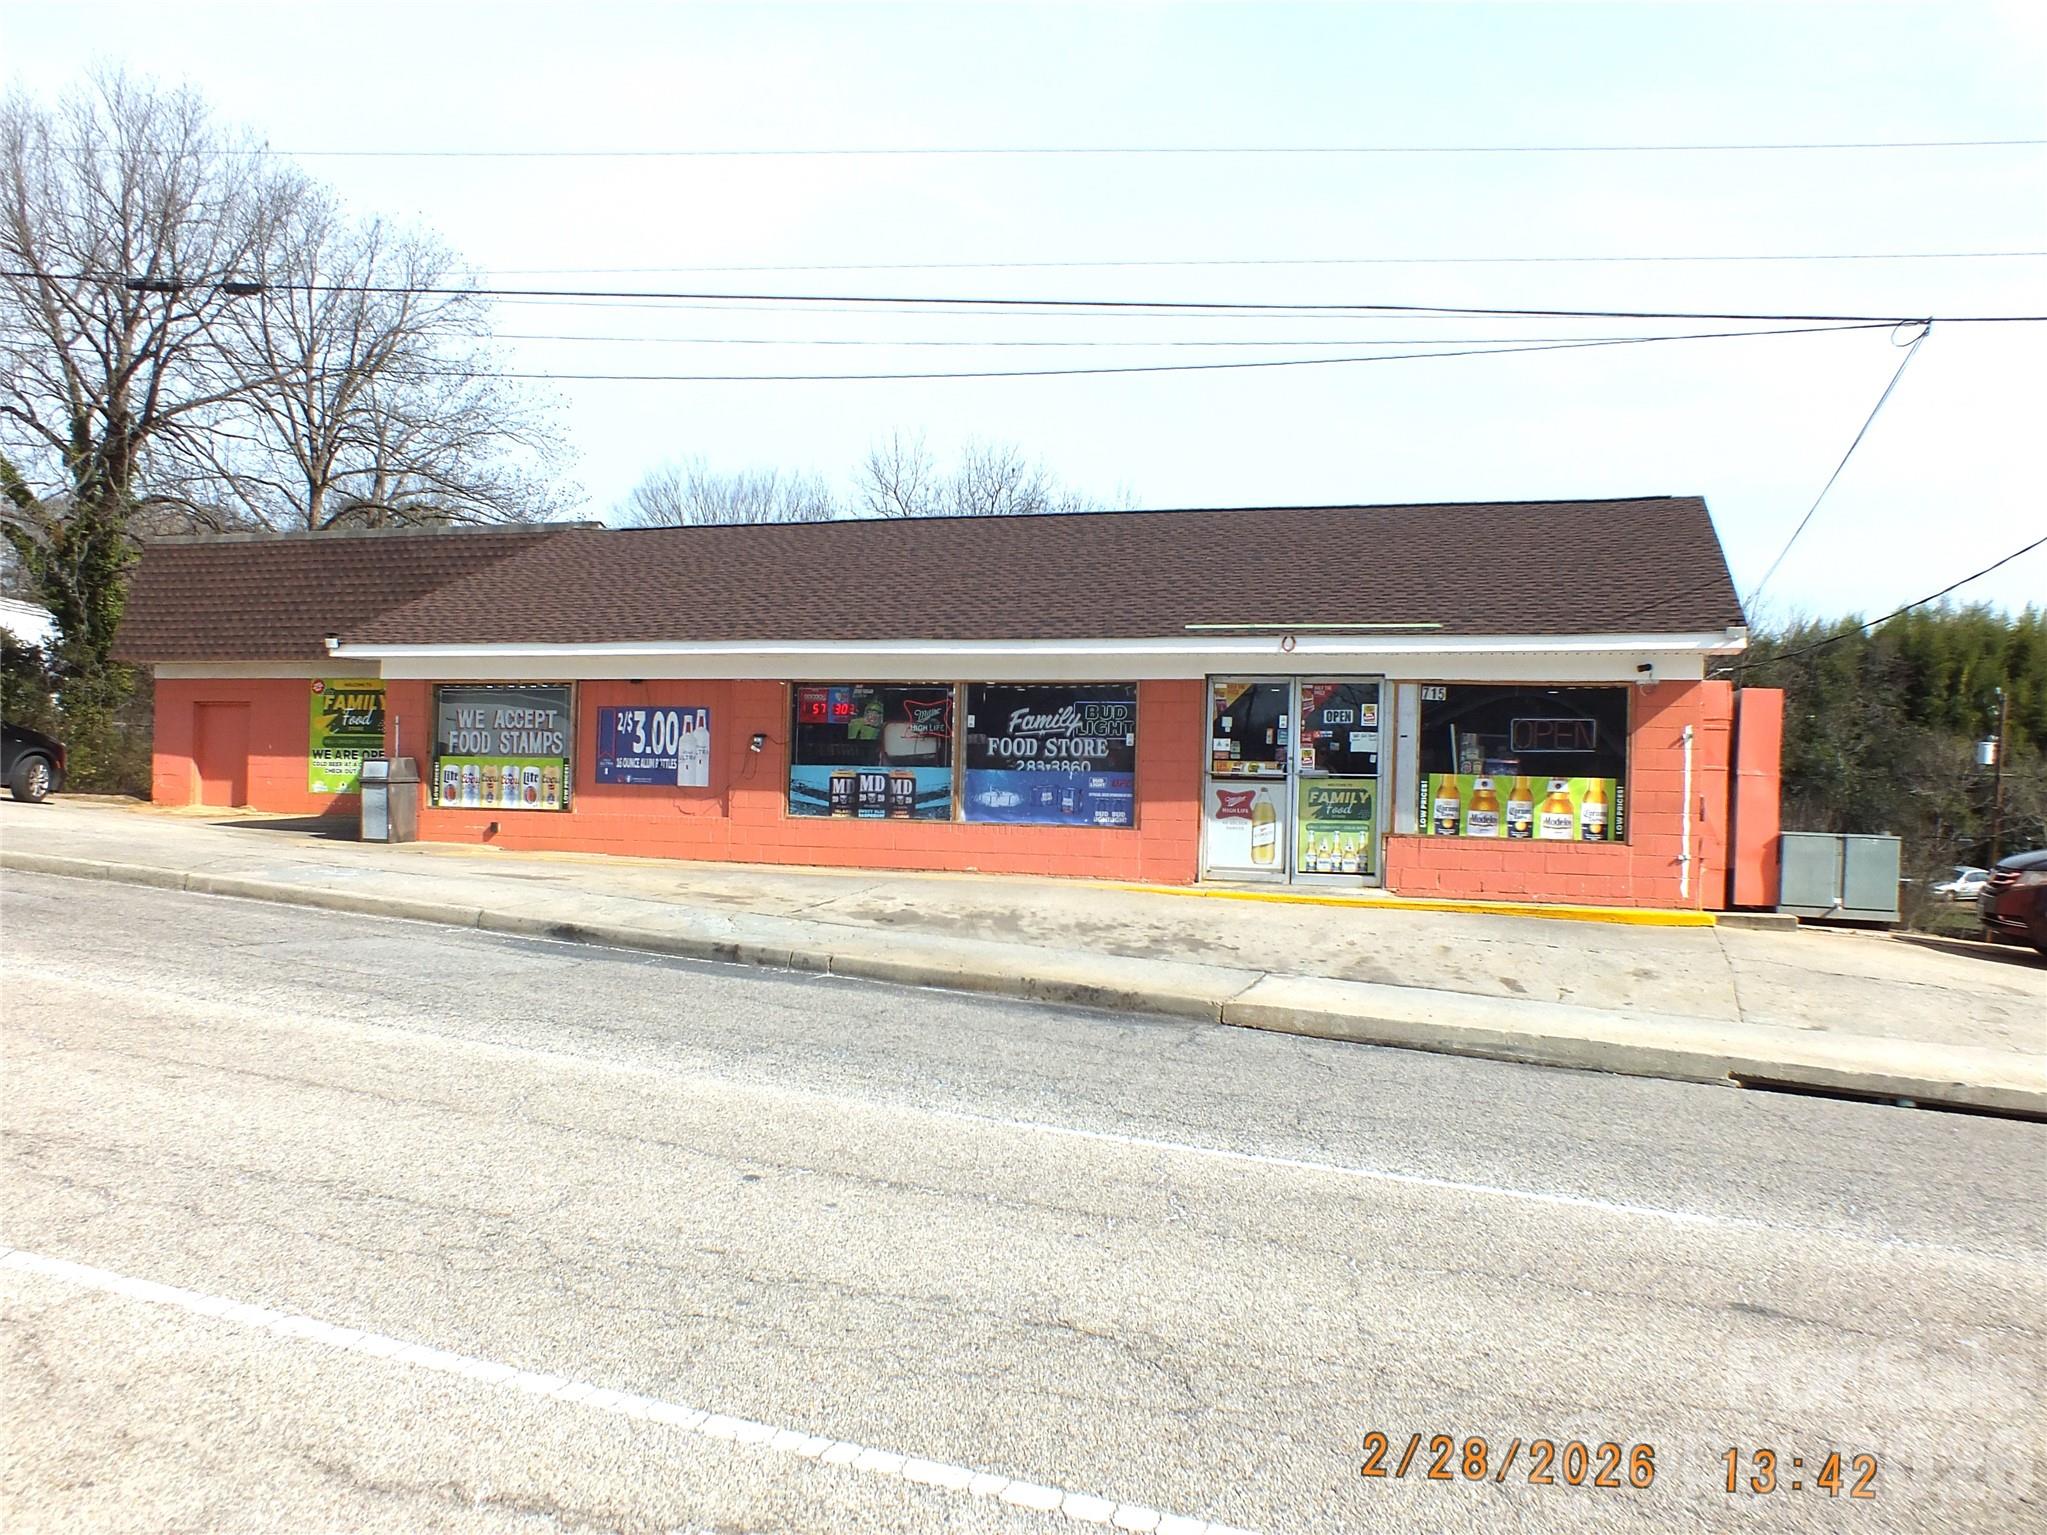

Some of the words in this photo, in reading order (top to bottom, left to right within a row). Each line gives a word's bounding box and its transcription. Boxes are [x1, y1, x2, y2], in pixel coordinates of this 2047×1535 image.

[1422, 688, 1444, 699] 715
[341, 708, 374, 726] Food
[457, 709, 485, 728] WE
[494, 709, 557, 729] ACCEPT
[1085, 705, 1128, 720] BUD
[1326, 710, 1352, 722] OPEN
[910, 724, 928, 732] HIGH
[929, 724, 945, 732] LIFE
[1009, 706, 1081, 737] Family
[1076, 720, 1134, 736] LIGHT
[449, 731, 491, 753] FOOD
[499, 731, 563, 754] STAMPS
[1514, 721, 1596, 749] OPEN
[987, 737, 1038, 756] FOOD
[1044, 737, 1109, 757] STORE
[312, 750, 331, 760] WE
[335, 750, 358, 760] ARE
[444, 770, 458, 783] Lite
[523, 772, 539, 785] Lite
[859, 775, 885, 792] MD
[890, 779, 913, 795] MD
[1310, 791, 1369, 804] FAMILY
[1326, 802, 1353, 814] Food
[1544, 817, 1571, 825] Modelo
